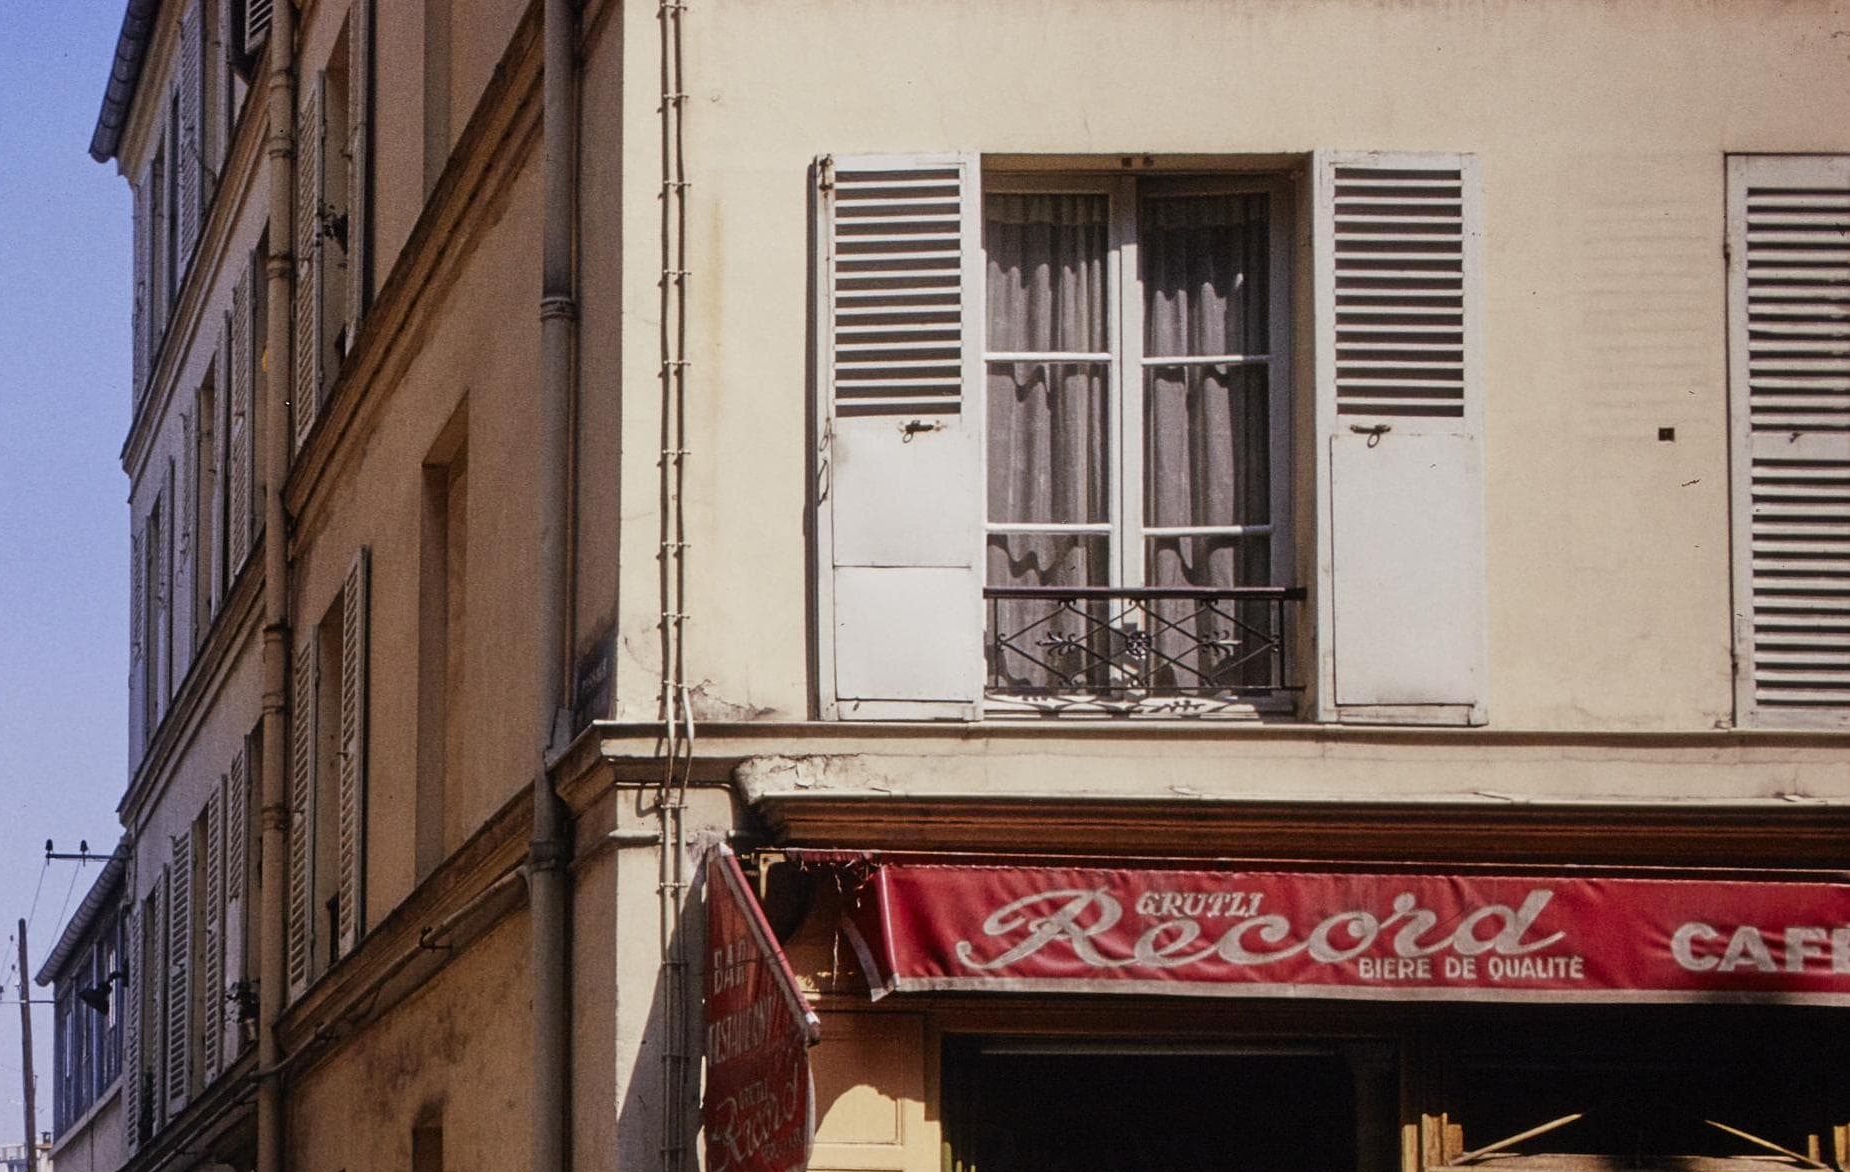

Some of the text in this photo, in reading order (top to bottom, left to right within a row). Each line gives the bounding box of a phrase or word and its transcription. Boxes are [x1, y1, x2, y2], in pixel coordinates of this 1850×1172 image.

[1135, 891, 1264, 918] GRUTLI
[955, 886, 1567, 969] Record
[1358, 957, 1432, 980] BIERE
[1444, 957, 1477, 980] DE
